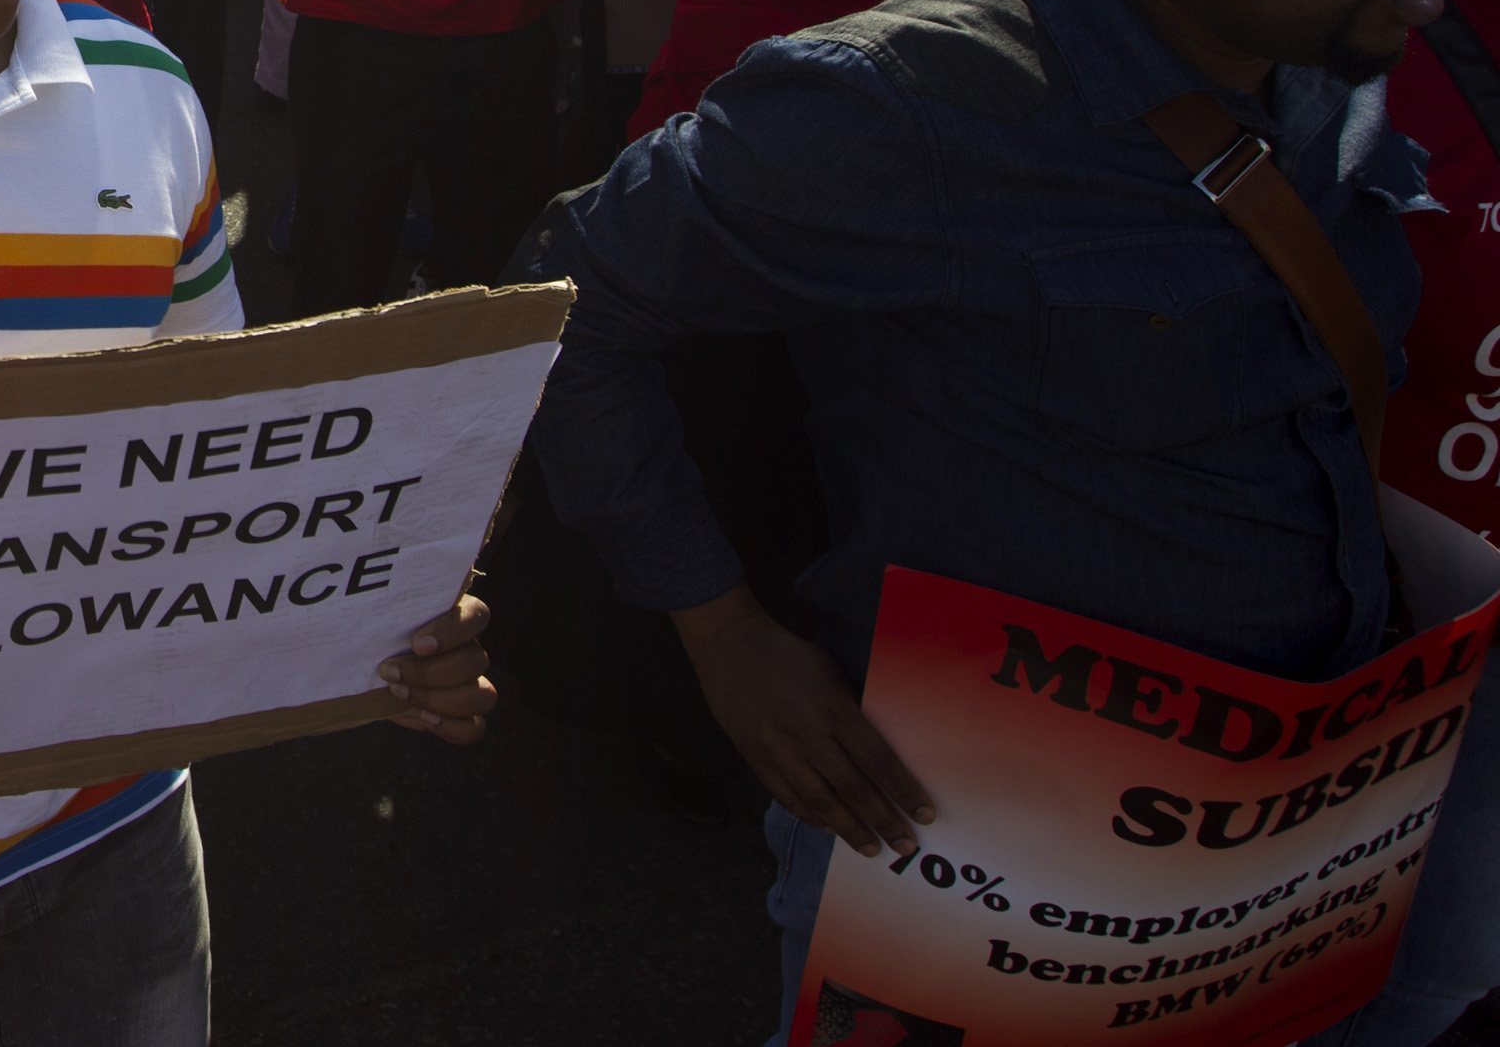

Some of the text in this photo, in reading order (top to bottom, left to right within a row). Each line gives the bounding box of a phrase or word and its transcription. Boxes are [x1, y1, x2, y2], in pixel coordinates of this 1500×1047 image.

[119, 406, 373, 489] NEED
[986, 869, 1381, 986] benchmarking
[1029, 871, 1308, 945] employer
[1106, 966, 1254, 1029] BMW
[1257, 902, 1388, 986] (69%)
